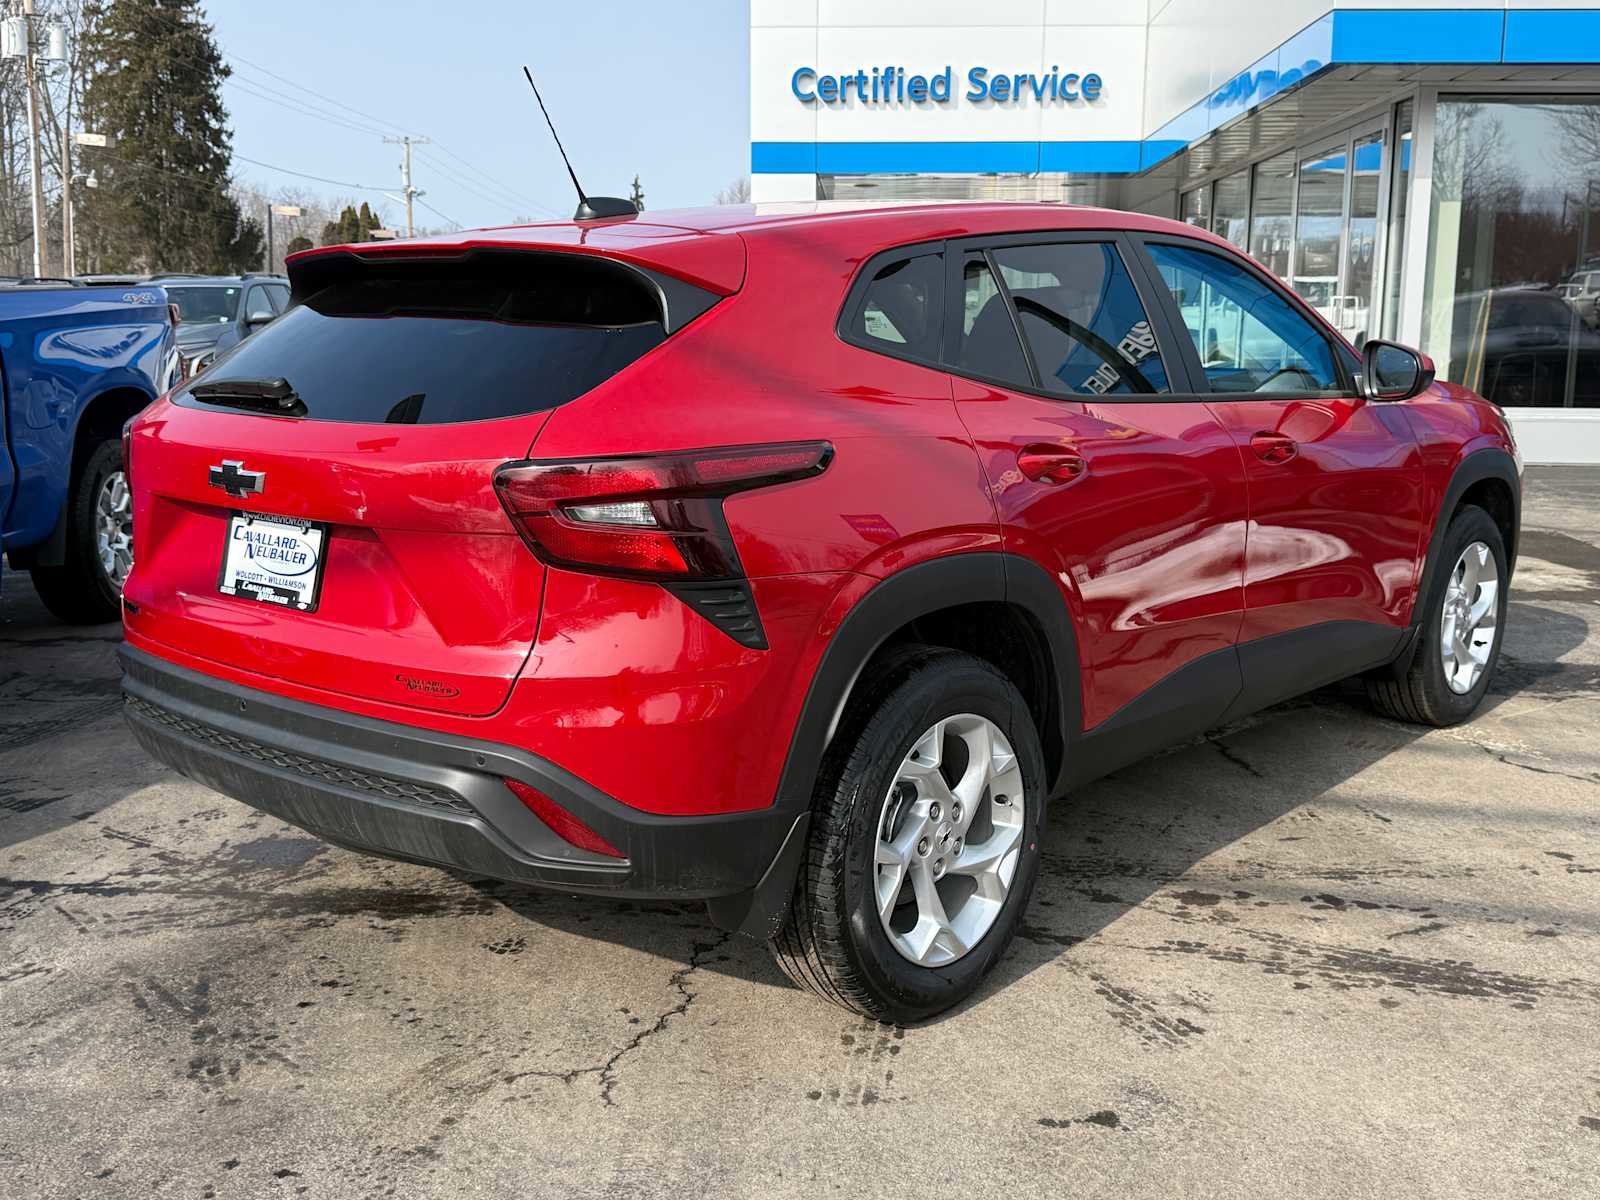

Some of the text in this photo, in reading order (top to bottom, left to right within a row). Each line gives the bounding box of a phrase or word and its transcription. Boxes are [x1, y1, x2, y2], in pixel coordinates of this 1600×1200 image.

[791, 65, 1103, 103] Certified Service
[244, 543, 307, 565] NEUBAUER
[235, 569, 307, 590] WOLCOTT WILLIAMSON
